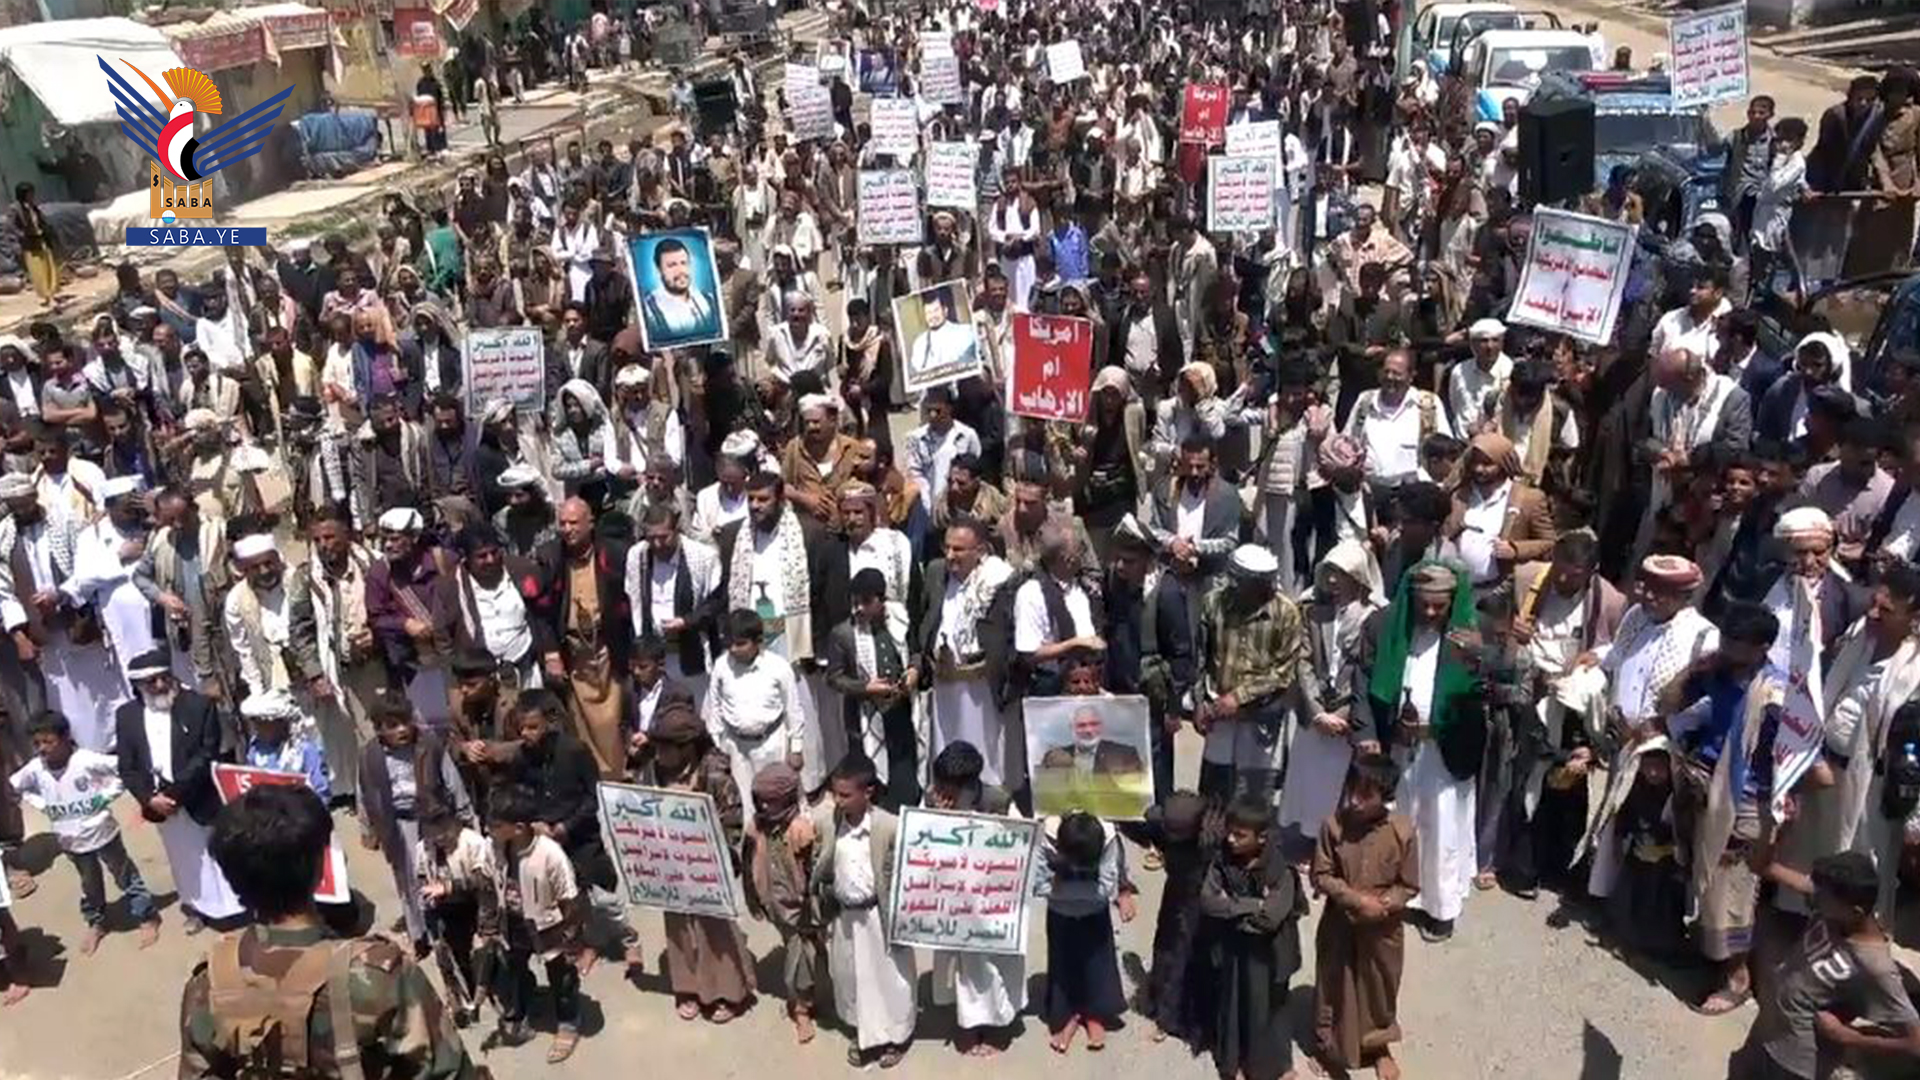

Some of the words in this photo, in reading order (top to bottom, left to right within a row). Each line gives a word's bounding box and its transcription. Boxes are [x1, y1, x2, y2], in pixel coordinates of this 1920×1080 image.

[669, 802, 708, 822] الله
[984, 829, 1030, 848] الله
[973, 856, 1025, 875] الموت
[971, 878, 1021, 897] الموت
[949, 901, 974, 916] على
[963, 920, 1016, 941] النصر
